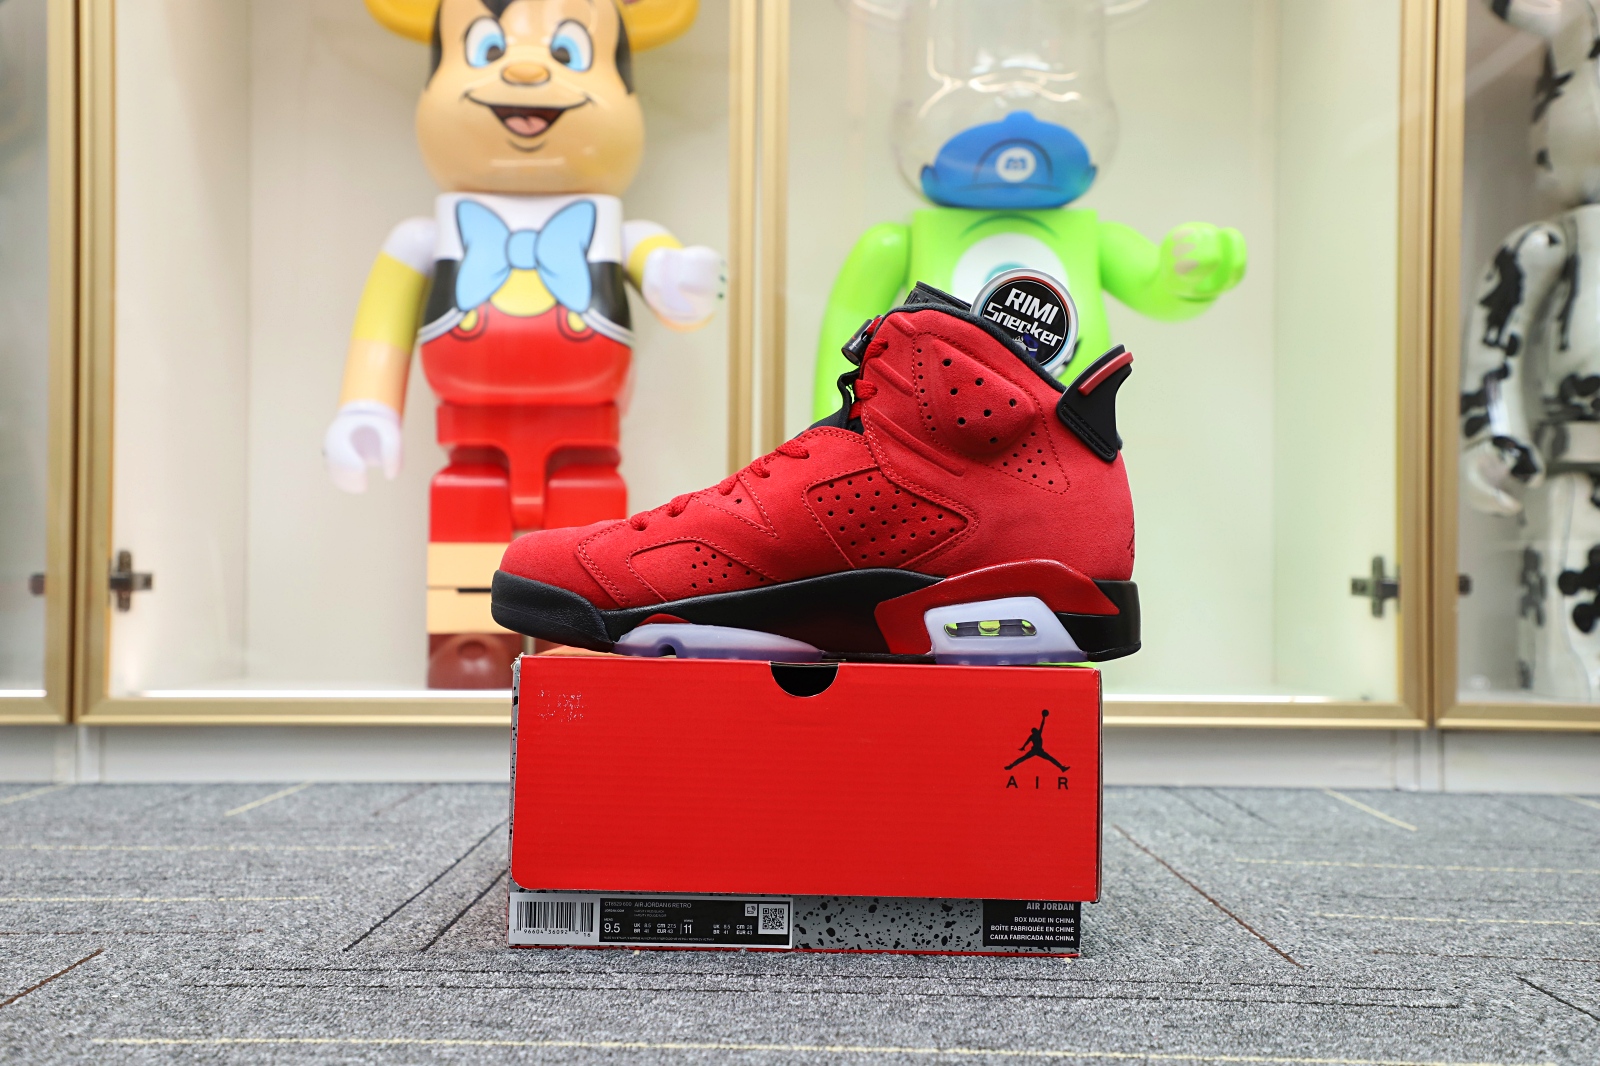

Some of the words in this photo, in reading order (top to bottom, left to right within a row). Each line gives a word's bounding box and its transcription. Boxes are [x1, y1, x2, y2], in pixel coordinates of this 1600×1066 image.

[1004, 287, 1059, 325] RIMI
[1005, 775, 1069, 790] AIR
[1026, 902, 1040, 910] AIR
[1043, 902, 1074, 911] JORDAN
[604, 922, 620, 933] 9.5
[684, 924, 692, 934] 11
